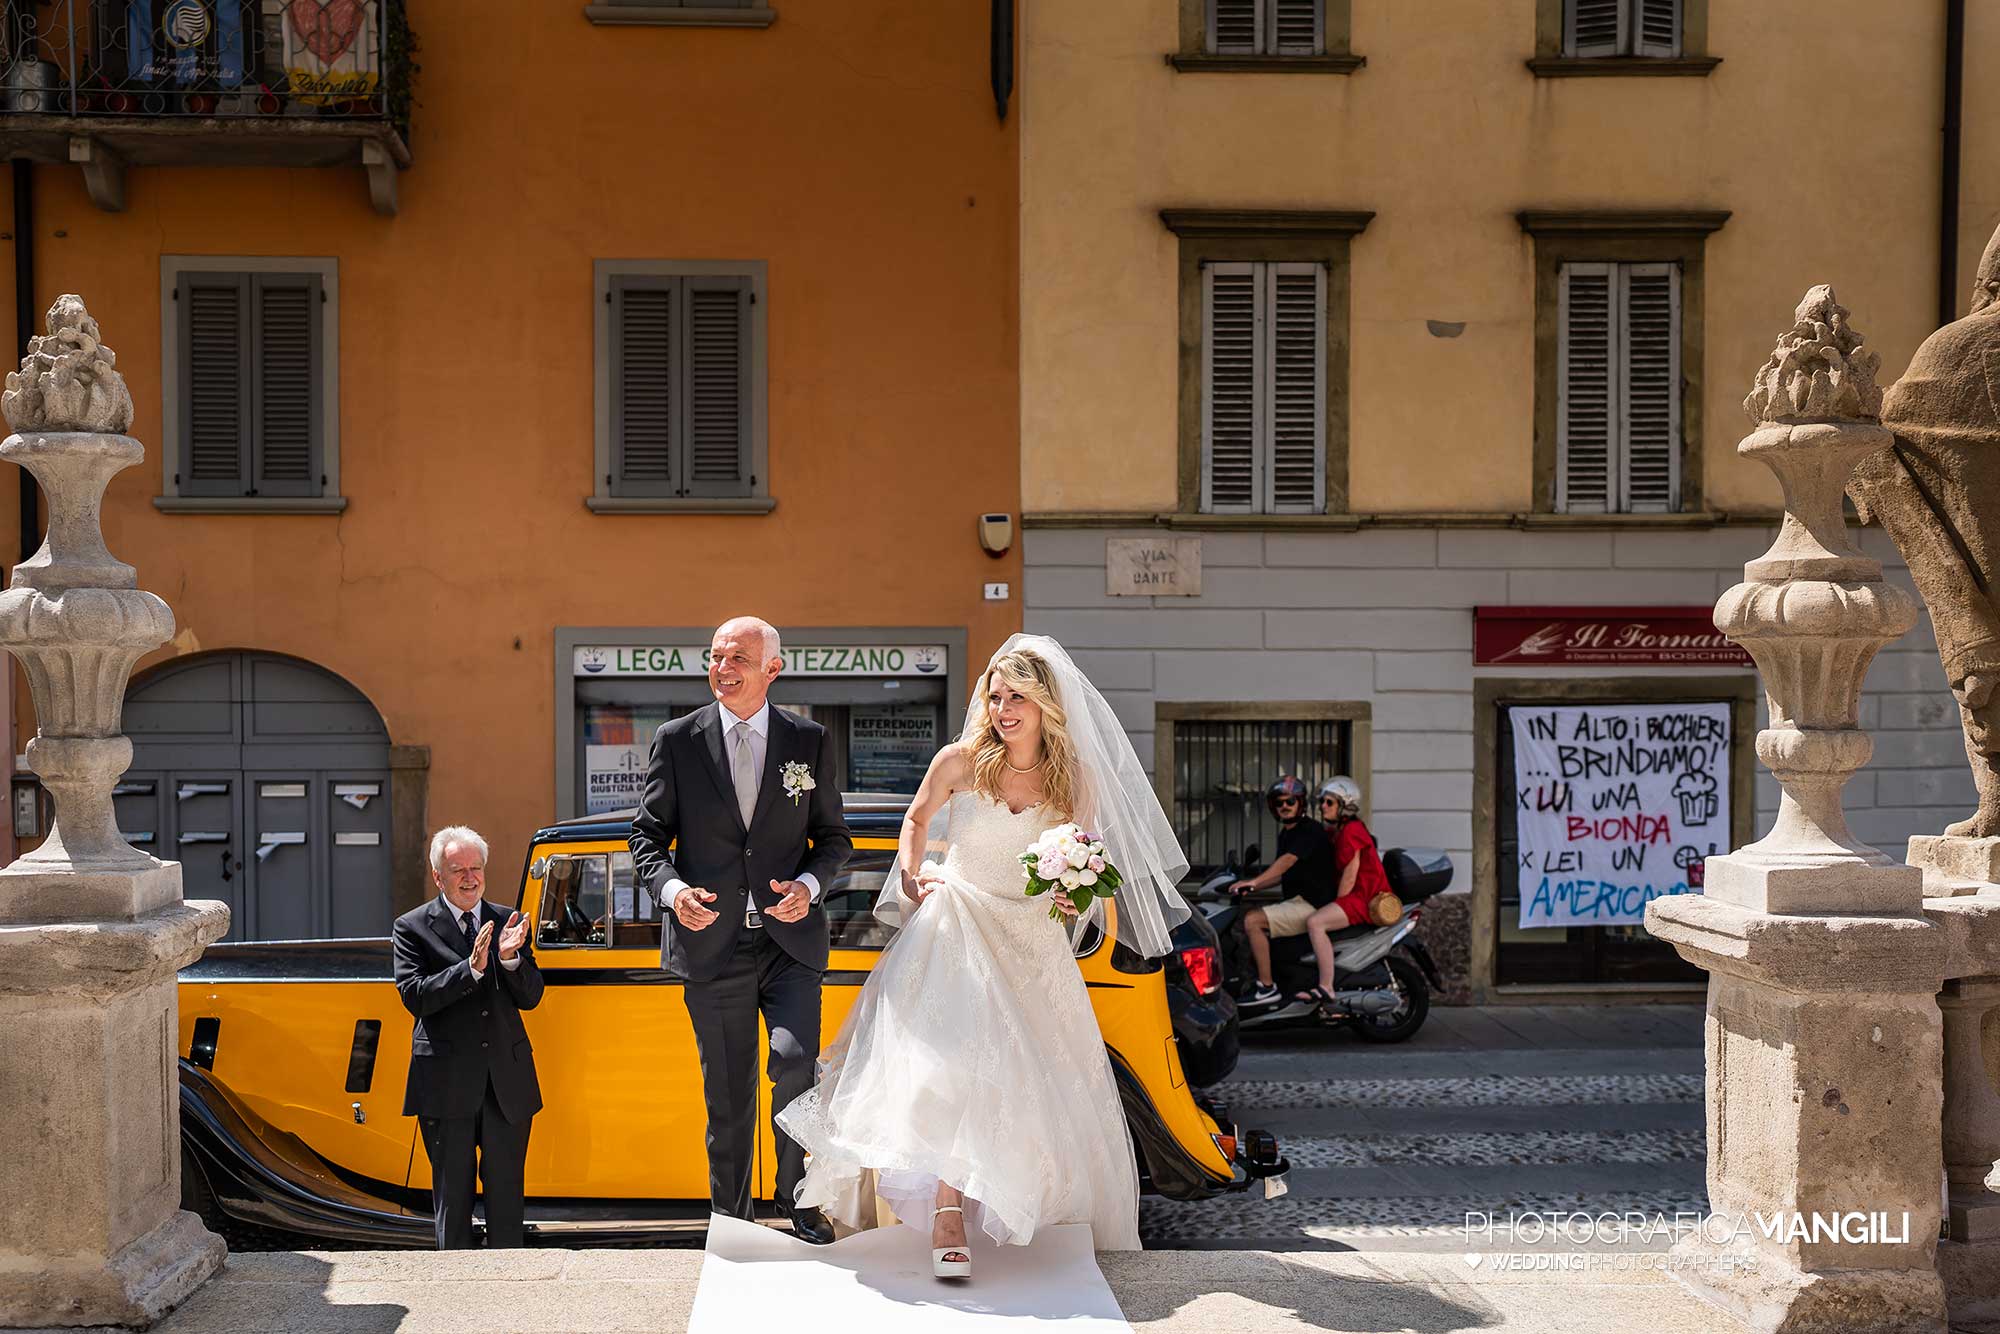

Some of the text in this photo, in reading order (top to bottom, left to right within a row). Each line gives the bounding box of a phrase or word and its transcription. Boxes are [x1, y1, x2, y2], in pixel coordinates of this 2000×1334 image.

[1140, 550, 1167, 561] VIA
[993, 586, 1000, 596] 4
[1566, 623, 1608, 648] Il
[616, 648, 685, 672] LEGA
[1658, 652, 1747, 661] BOSCHINI
[853, 719, 933, 729] REFERENDUM
[1527, 712, 1557, 740] IN
[1574, 712, 1629, 741] ALTO
[854, 730, 897, 738] GIUSTIZIA
[590, 784, 634, 793] GIUSTIZIA
[1536, 780, 1574, 813] LUI
[1566, 813, 1671, 845] BIONDA
[1543, 850, 1583, 873] LEI
[1612, 843, 1646, 872] UN
